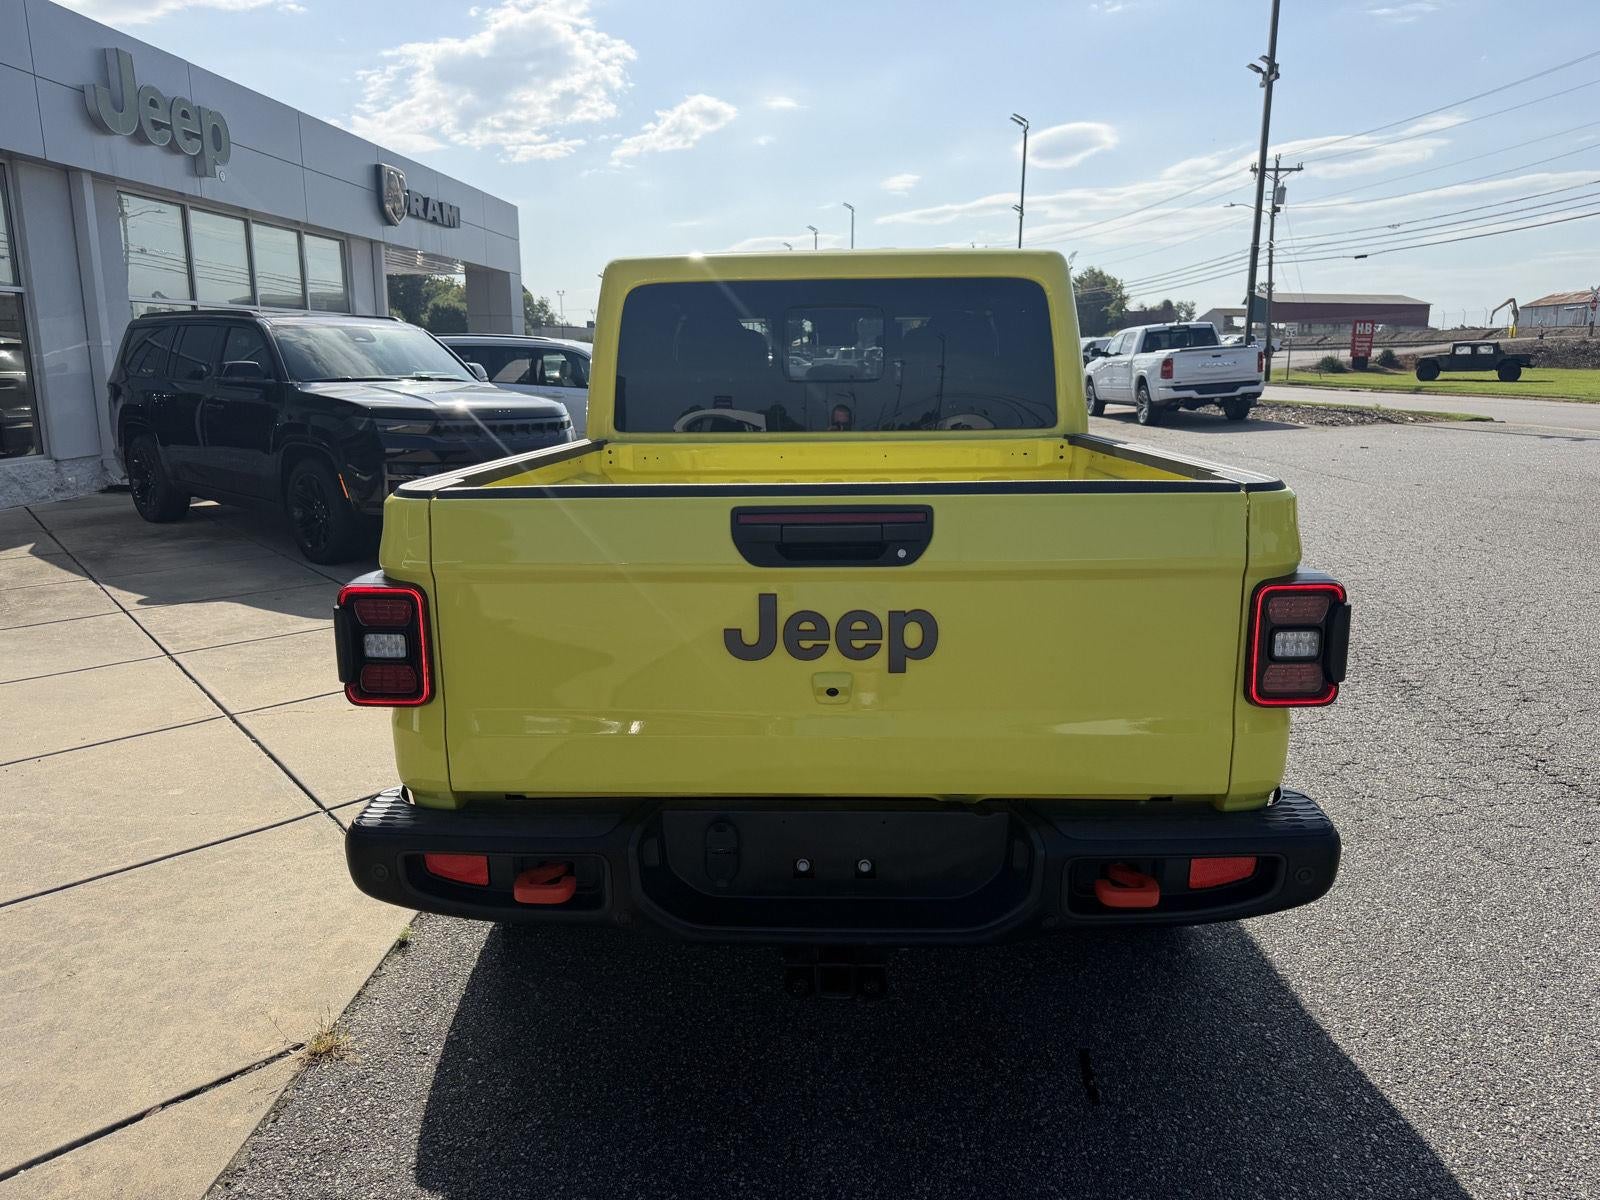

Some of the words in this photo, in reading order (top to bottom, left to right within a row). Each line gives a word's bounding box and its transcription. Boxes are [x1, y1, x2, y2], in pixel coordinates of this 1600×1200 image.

[83, 47, 231, 178] Jeep
[408, 189, 460, 228] RAM
[723, 593, 939, 674] Jeep
